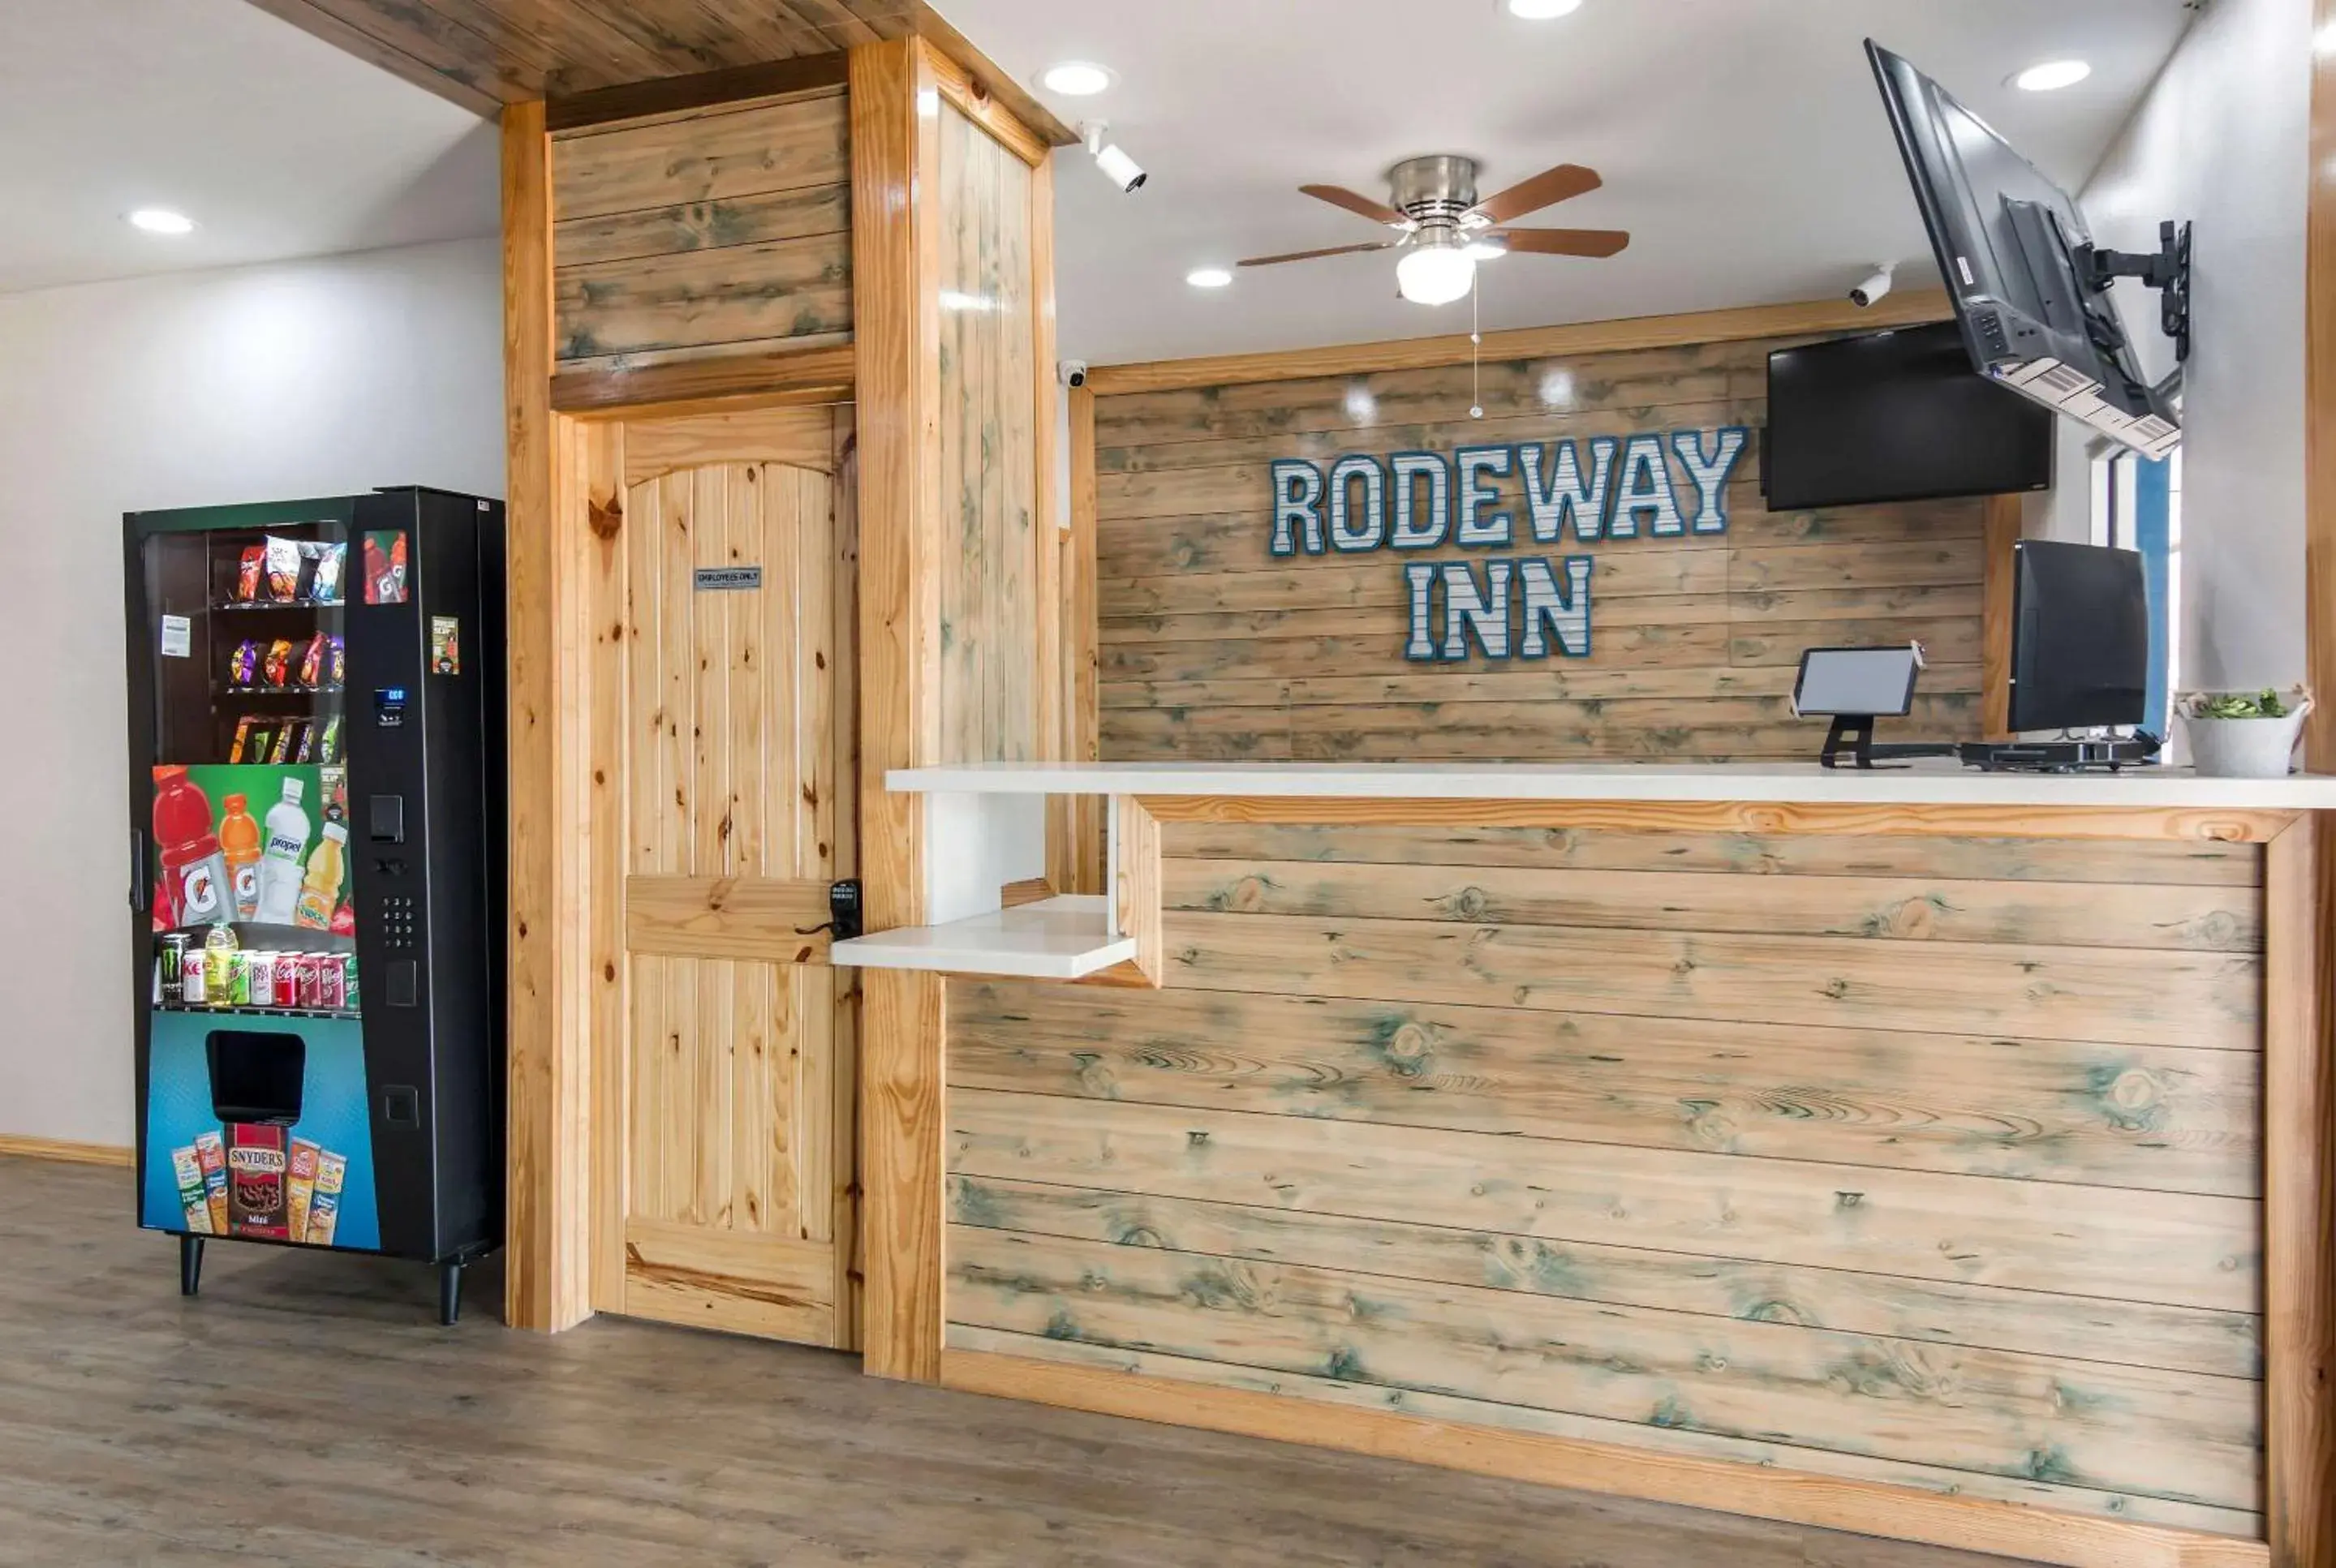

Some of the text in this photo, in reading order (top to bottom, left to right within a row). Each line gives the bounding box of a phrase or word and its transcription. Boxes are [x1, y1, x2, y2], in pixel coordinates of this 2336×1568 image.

[1270, 426, 1749, 556] RODEWAY
[698, 572, 758, 582] EMPLOYEES ONLY
[1405, 555, 1594, 662] INN
[270, 836, 302, 853] propel
[231, 1149, 283, 1167] SNYDER'S
